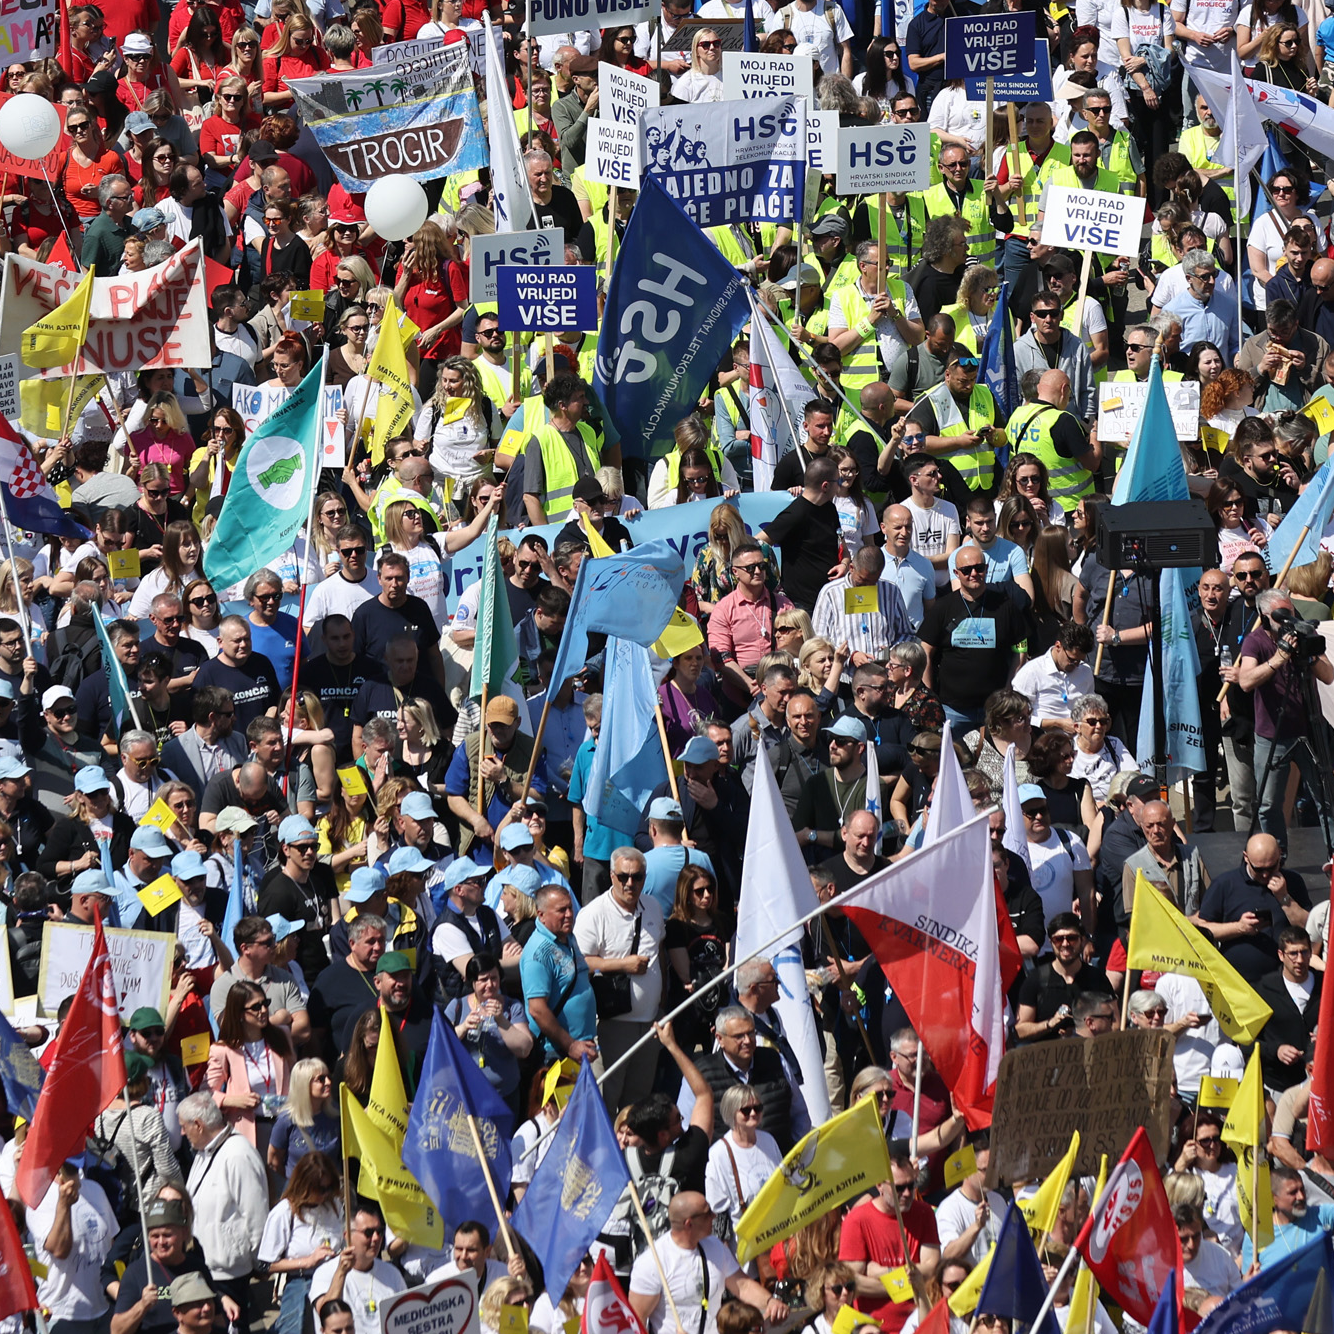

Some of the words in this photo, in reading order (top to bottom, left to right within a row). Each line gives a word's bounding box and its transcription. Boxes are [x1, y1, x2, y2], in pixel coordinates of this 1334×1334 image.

[1197, 0, 1227, 8] PROLJEĆE
[963, 22, 991, 34] MOJ
[993, 20, 1018, 32] RAD
[963, 34, 1018, 48] VRIJEDI
[740, 61, 767, 73] MOJ
[770, 62, 795, 73] RAD
[964, 46, 1017, 72] V!ŠE
[609, 74, 628, 88] MOJ
[630, 78, 647, 94] RAD
[741, 74, 795, 86] VRIJEDI
[611, 87, 648, 109] VRIJEDI
[598, 126, 615, 139] MOJ
[617, 130, 635, 142] RAD
[338, 128, 449, 177] TROGIR
[598, 142, 634, 158] VRIJEDI
[735, 145, 767, 154] HRVATSKI
[768, 142, 797, 152] SINDIKAT
[735, 148, 797, 162] TELEKOMUNIKACIJA
[768, 164, 795, 188] ZA
[849, 173, 883, 181] HRVATSKI
[884, 171, 917, 180] SINDIKAT
[849, 180, 917, 188] TELEKOMUNIKACIJA
[723, 192, 795, 224] PLAĆE
[1067, 194, 1095, 208] MOJ
[1097, 198, 1125, 212] RAD
[1067, 208, 1123, 226] VRIJEDI
[1064, 222, 1120, 248] V!ŠE
[516, 274, 543, 285] MOJ
[547, 273, 577, 284] RAD
[516, 288, 577, 300] VRIJEDI
[518, 300, 577, 327] V!ŠE
[235, 388, 263, 415] AKO
[132, 943, 155, 961] SMO
[878, 916, 968, 972] KVARNERA
[123, 976, 142, 994] NAM
[393, 1294, 465, 1328] MEDICINSKA
[407, 1313, 455, 1334] SESTRA
